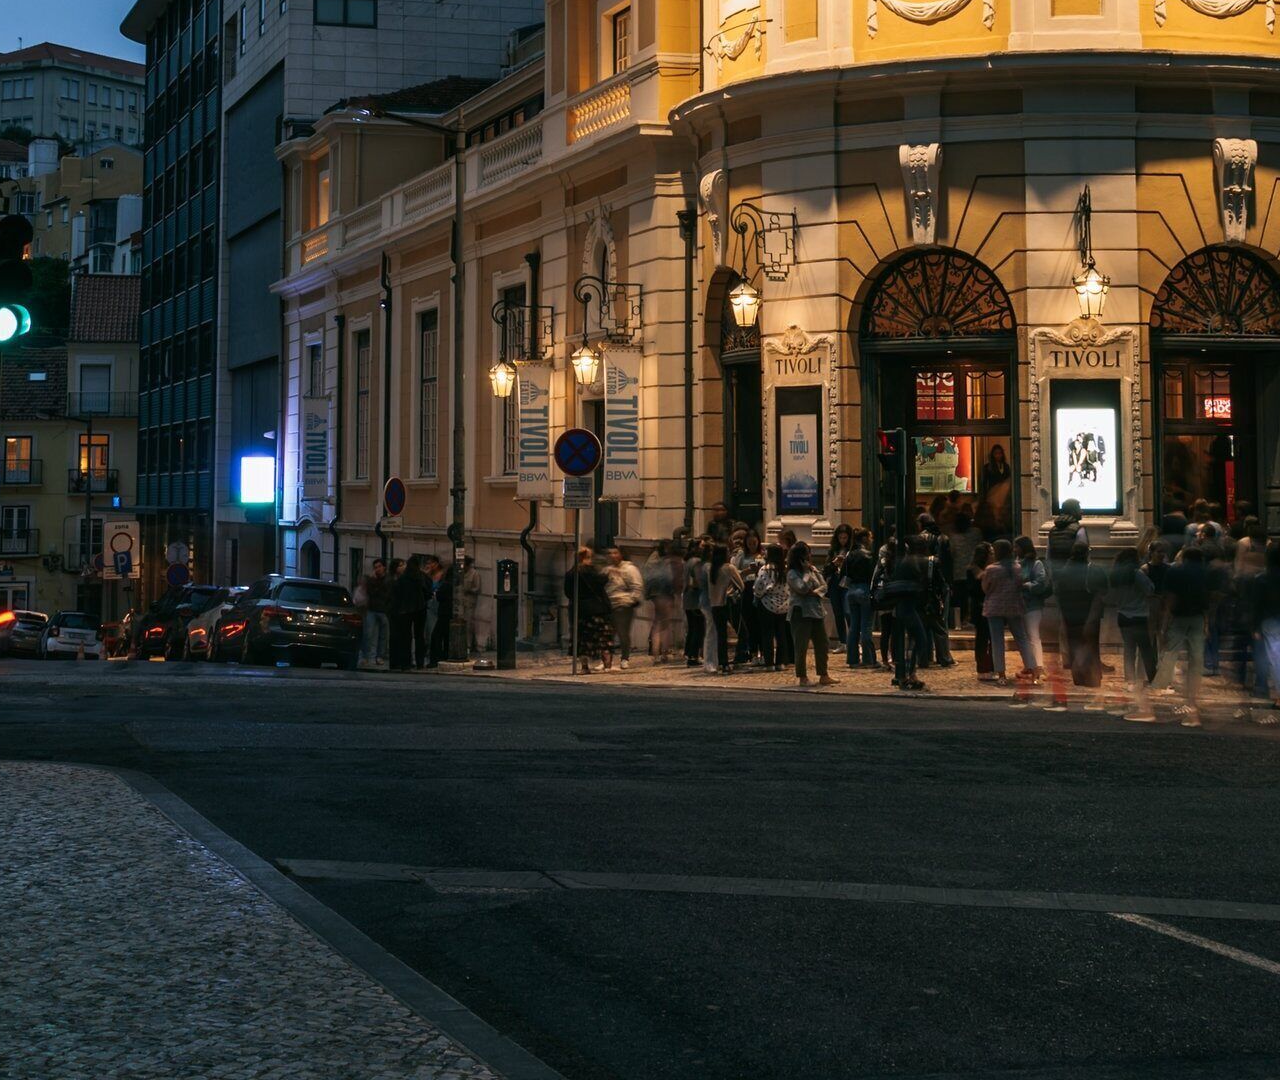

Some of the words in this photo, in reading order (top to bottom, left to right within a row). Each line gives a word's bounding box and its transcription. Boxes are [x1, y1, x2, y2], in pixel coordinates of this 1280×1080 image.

[775, 357, 823, 376] TIVOLI
[1048, 350, 1121, 368] TIVOLI
[606, 366, 617, 395] TEATRO
[519, 405, 549, 468] TIVOLI
[606, 395, 639, 465] TIVOLI
[305, 430, 327, 475] TIVOLI
[519, 472, 549, 482] BBVA
[605, 470, 638, 481] BBVA
[116, 553, 129, 573] P
